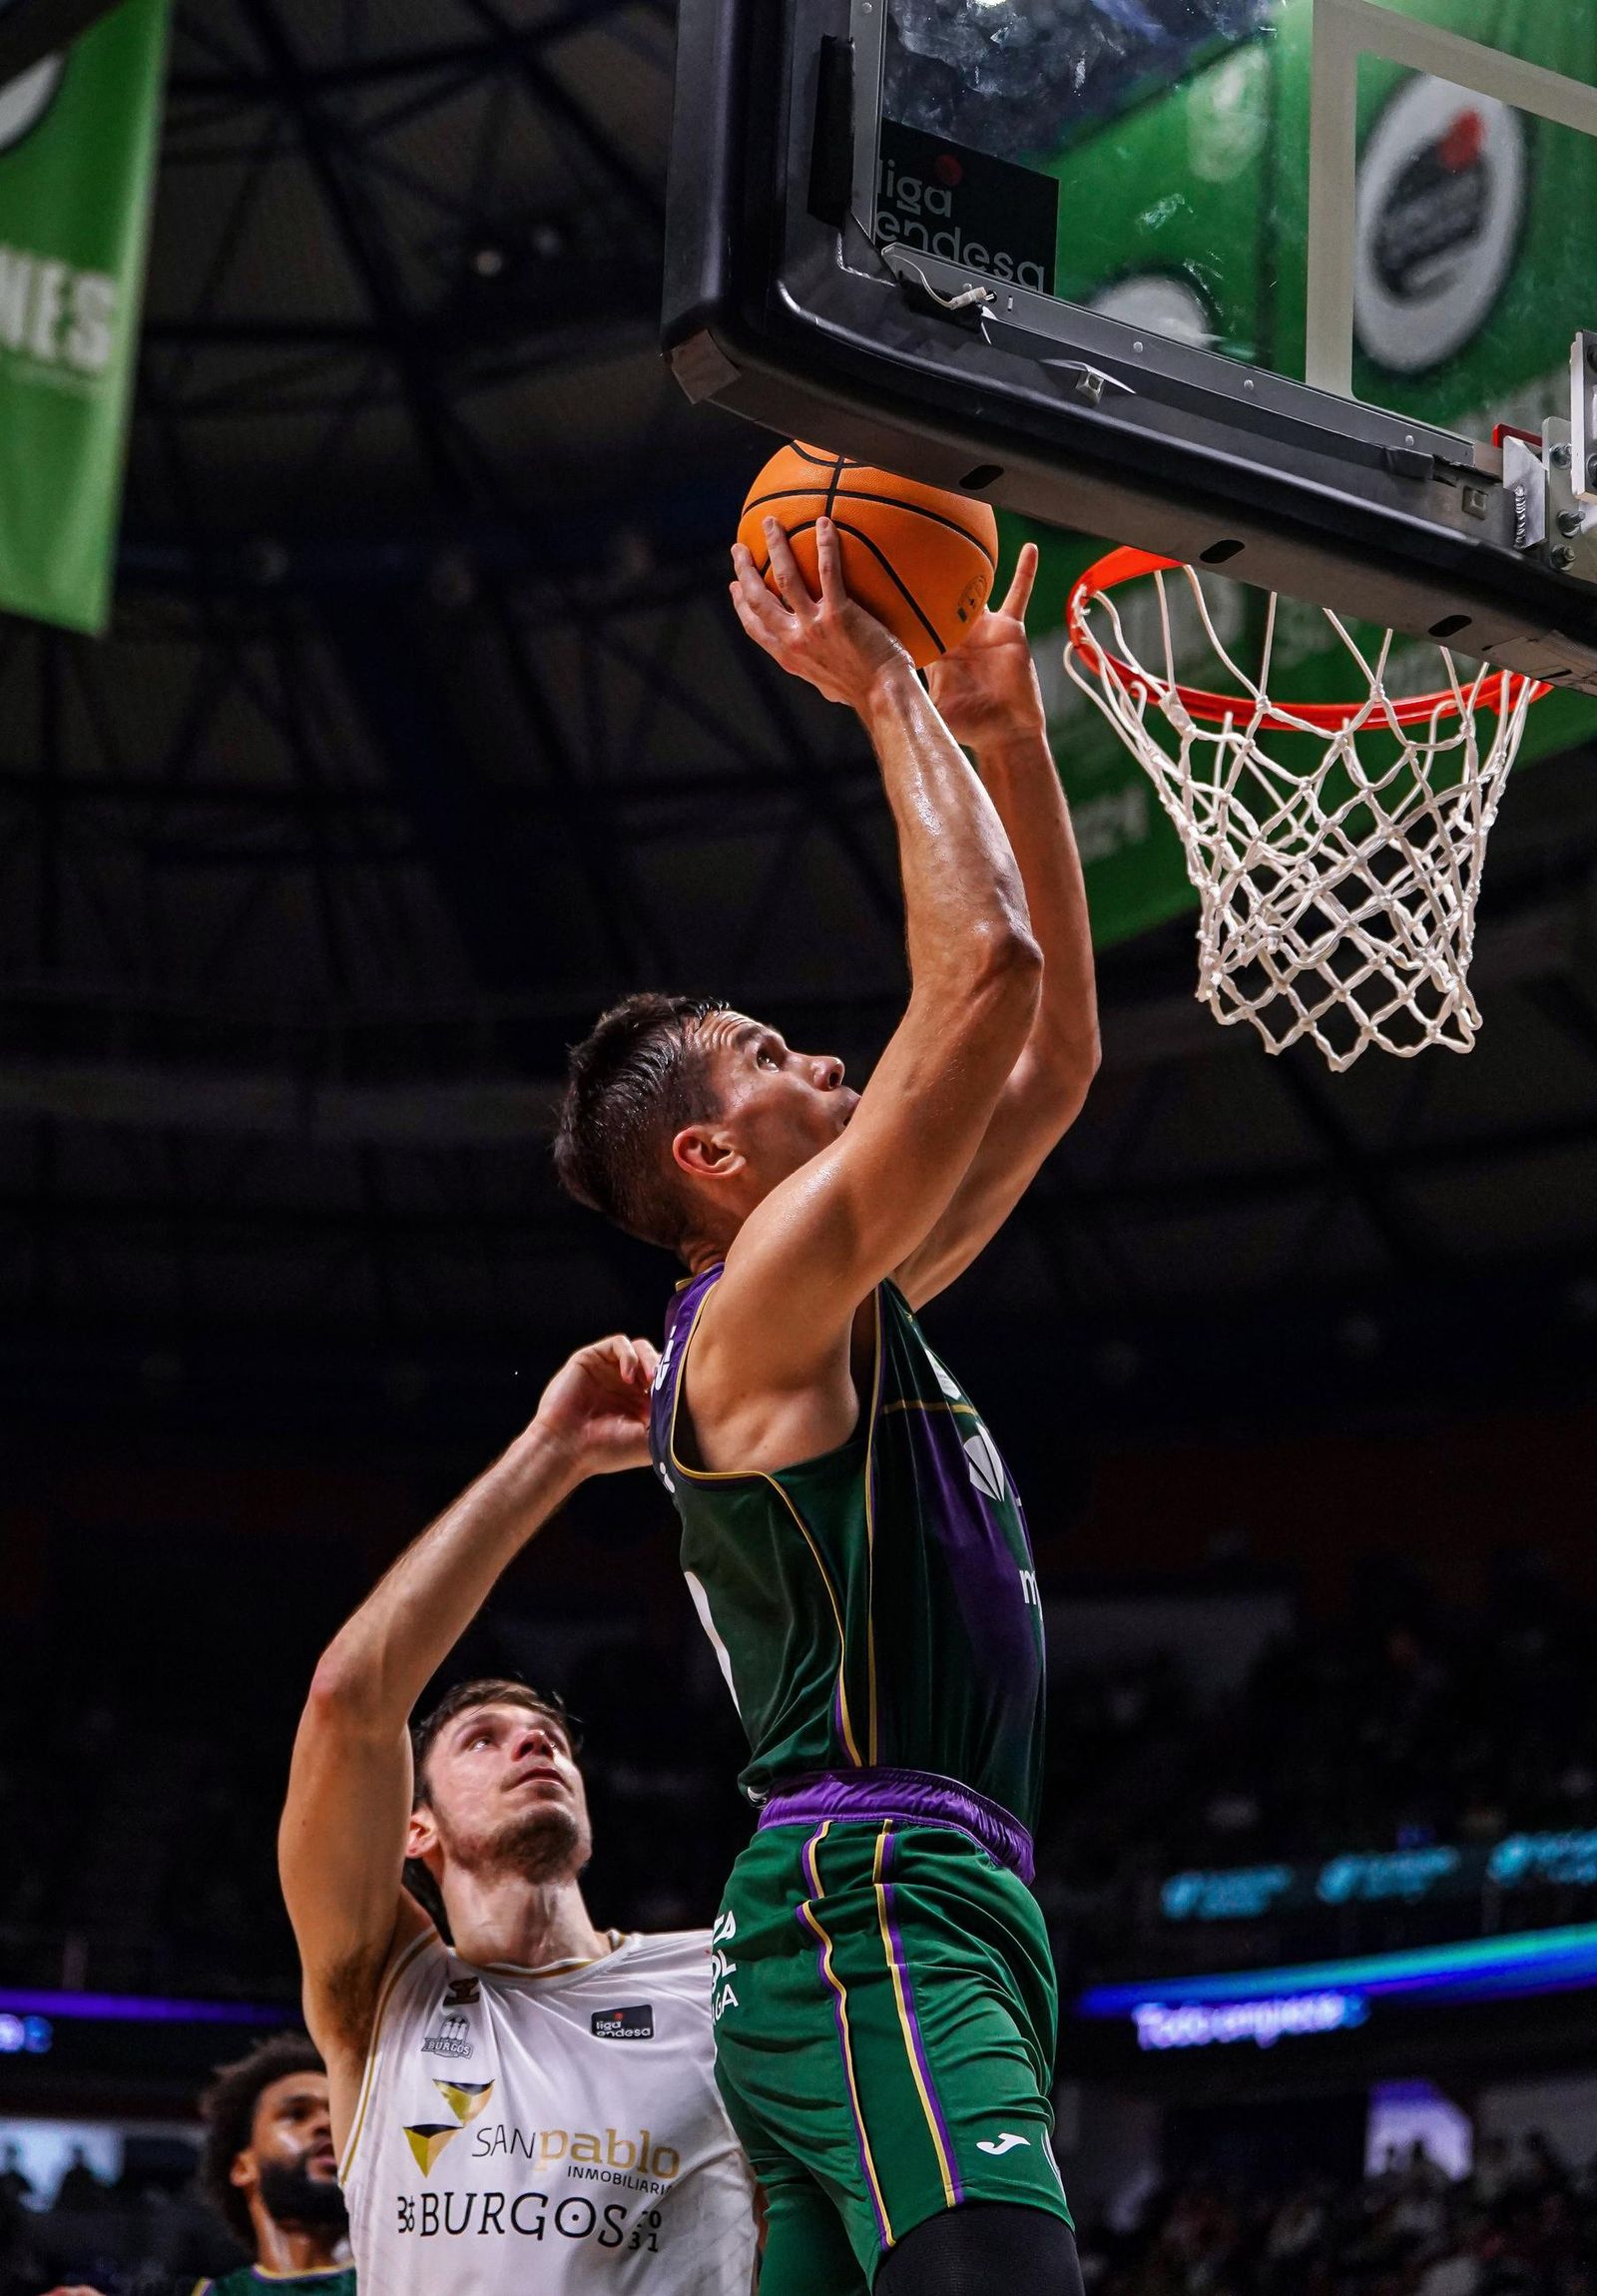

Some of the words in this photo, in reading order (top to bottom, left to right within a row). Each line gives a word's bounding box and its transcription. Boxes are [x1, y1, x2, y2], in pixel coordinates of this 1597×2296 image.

[876, 158, 952, 218] liga
[874, 211, 1045, 292] endesa
[596, 2020, 622, 2030] liga
[596, 2027, 651, 2037] endesa
[427, 2040, 470, 2055] BURGOS
[420, 2192, 627, 2247] BURGOS
